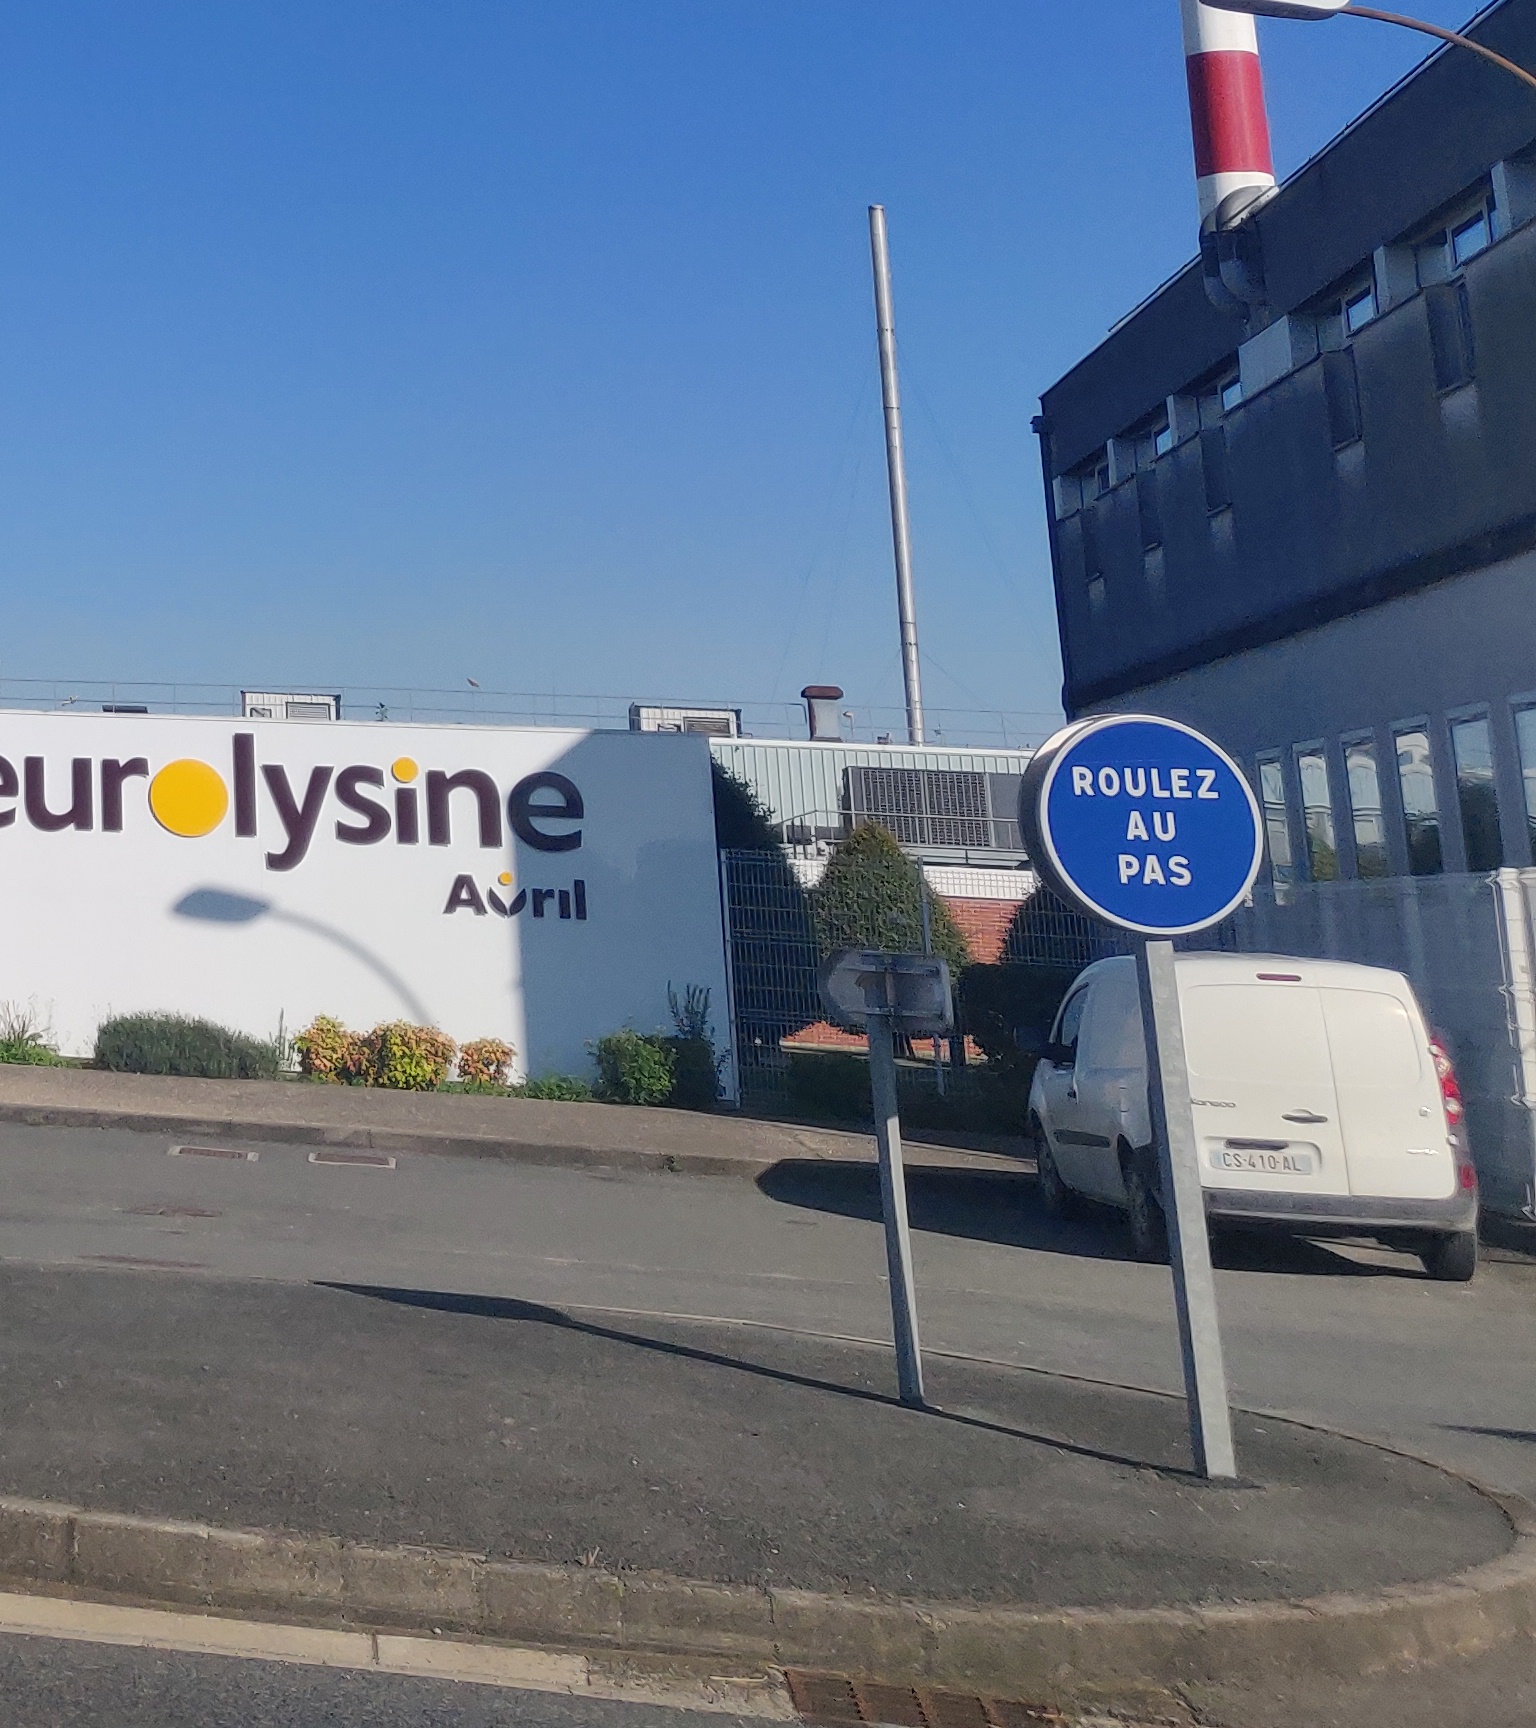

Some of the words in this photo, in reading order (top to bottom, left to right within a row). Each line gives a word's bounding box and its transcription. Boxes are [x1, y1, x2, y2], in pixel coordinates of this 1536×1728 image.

[1071, 766, 1219, 799] ROULEZ
[1126, 810, 1177, 842] AU
[1118, 854, 1192, 886] PAS
[442, 872, 587, 920] Avril
